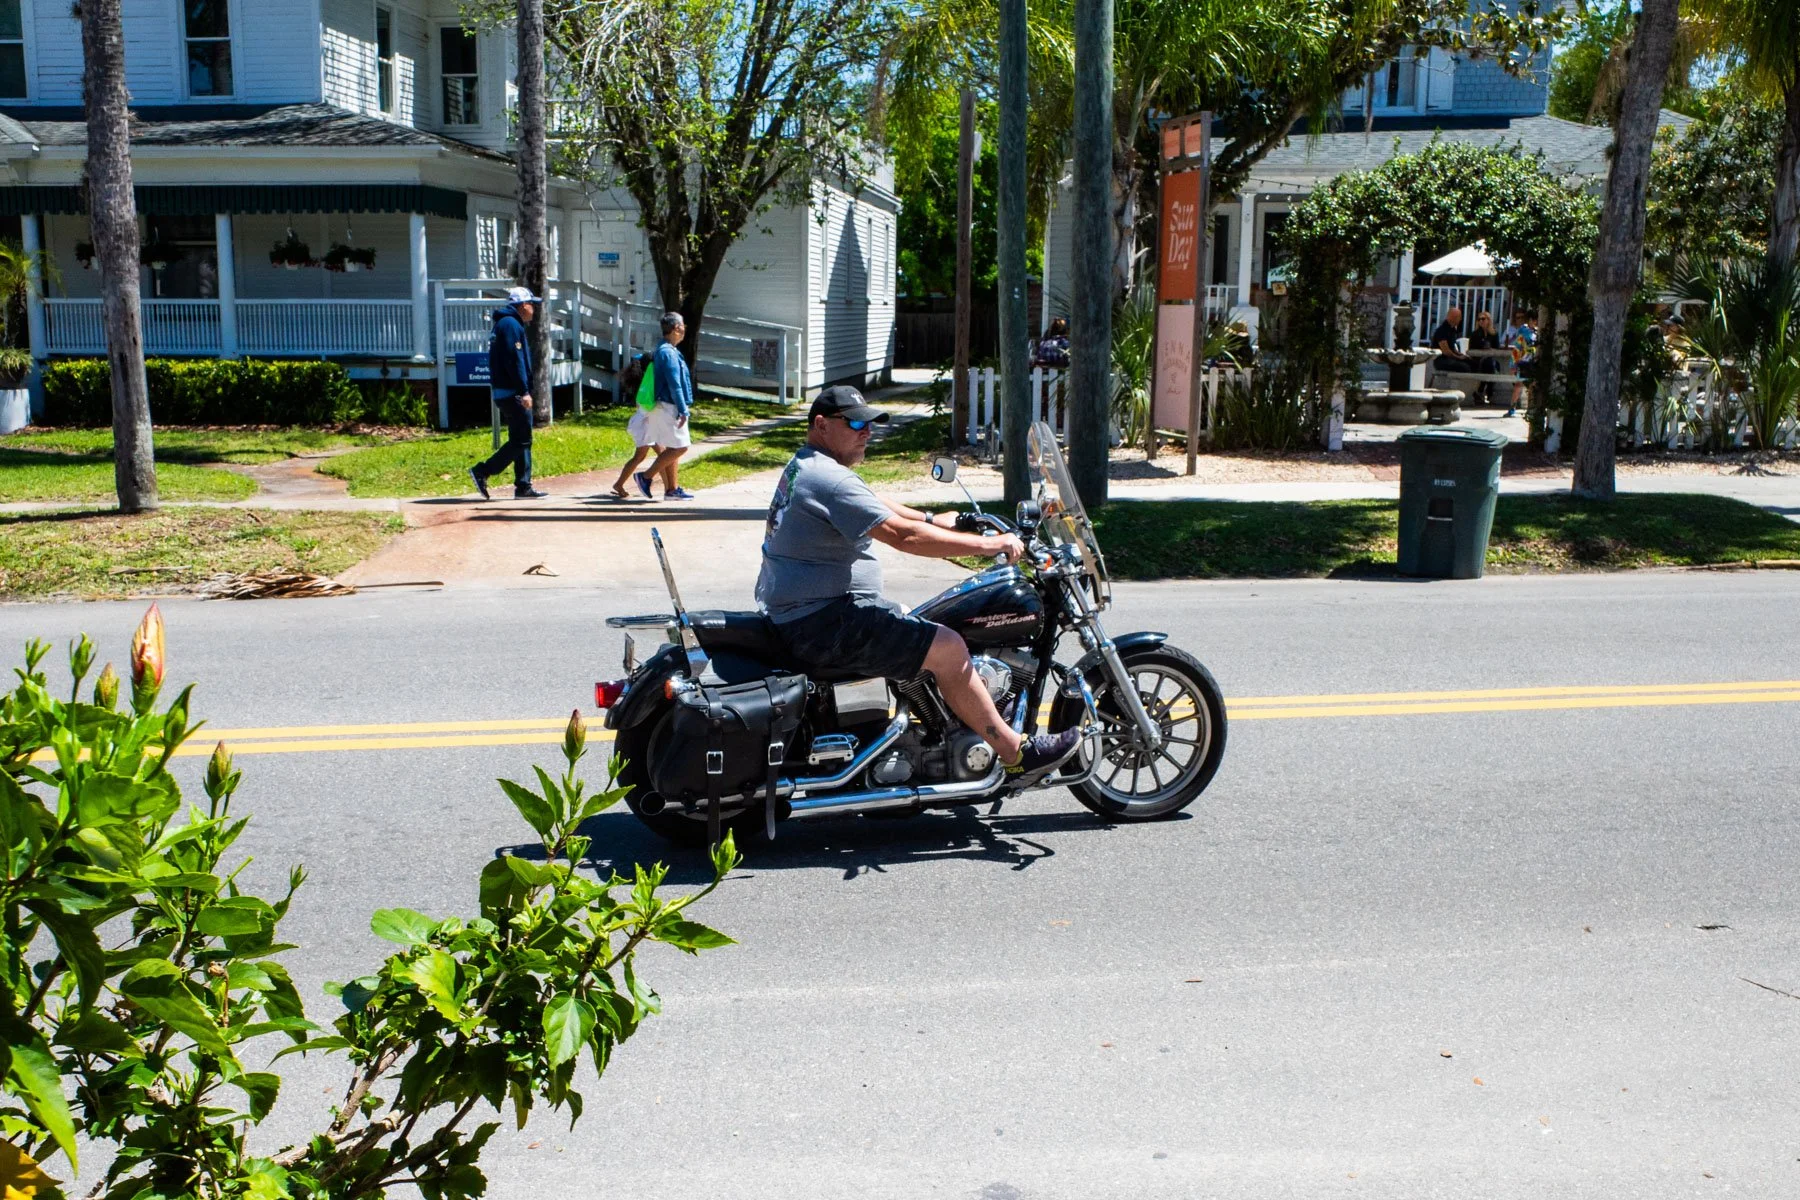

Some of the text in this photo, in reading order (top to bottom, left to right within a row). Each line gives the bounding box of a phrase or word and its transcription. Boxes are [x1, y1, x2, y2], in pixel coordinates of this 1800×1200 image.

[1169, 201, 1194, 232] Sun
[1167, 233, 1194, 270] Day
[469, 373, 491, 381] Entran
[984, 614, 1037, 629] Davidson
